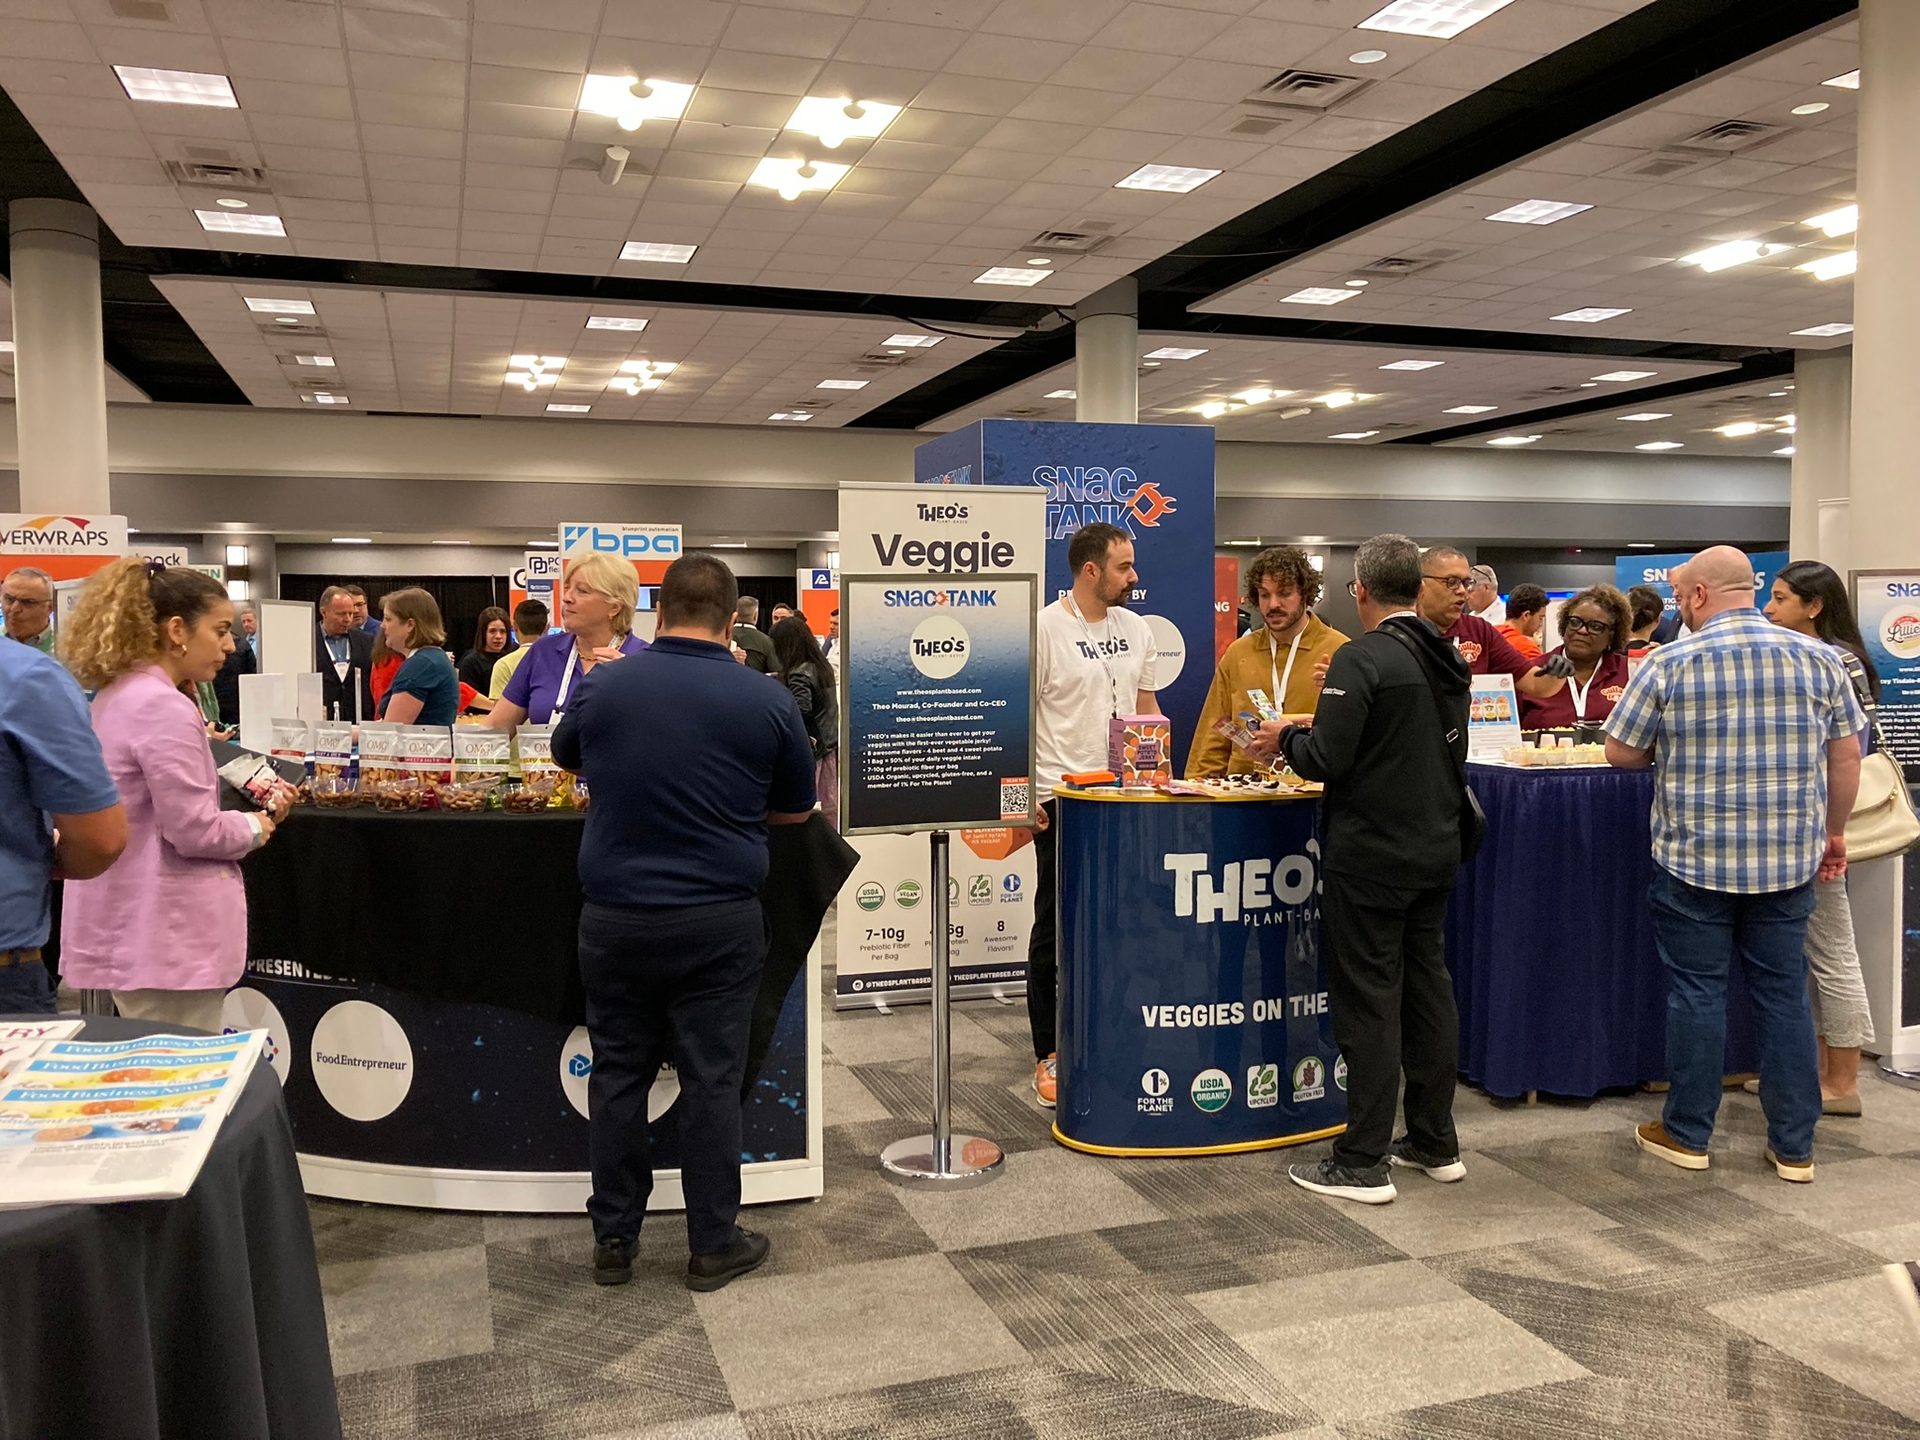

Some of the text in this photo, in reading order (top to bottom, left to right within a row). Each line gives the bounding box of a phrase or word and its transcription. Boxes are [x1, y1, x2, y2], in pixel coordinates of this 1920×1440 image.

[592, 527, 679, 557] bpa
[871, 531, 1014, 574] Veggie
[1132, 590, 1147, 600] BY
[891, 702, 921, 710] Mourad,
[921, 701, 964, 709] Co-Founder
[1164, 838, 1323, 923] THEO'
[1244, 908, 1321, 926] PLANT-BA
[865, 920, 1005, 942] 7-10g 8
[984, 935, 1018, 943] Awesome
[860, 941, 911, 951] Prebiotic Fiber
[884, 953, 899, 961] Bag
[1142, 992, 1328, 1028] VEGGIES ON THE
[316, 1051, 407, 1071] FoodEntrepreneur
[1200, 1078, 1224, 1089] USDA
[1137, 1097, 1174, 1105] FOR THE
[1196, 1091, 1227, 1101] ORGANIC
[1249, 1096, 1276, 1106] UPCYCLED
